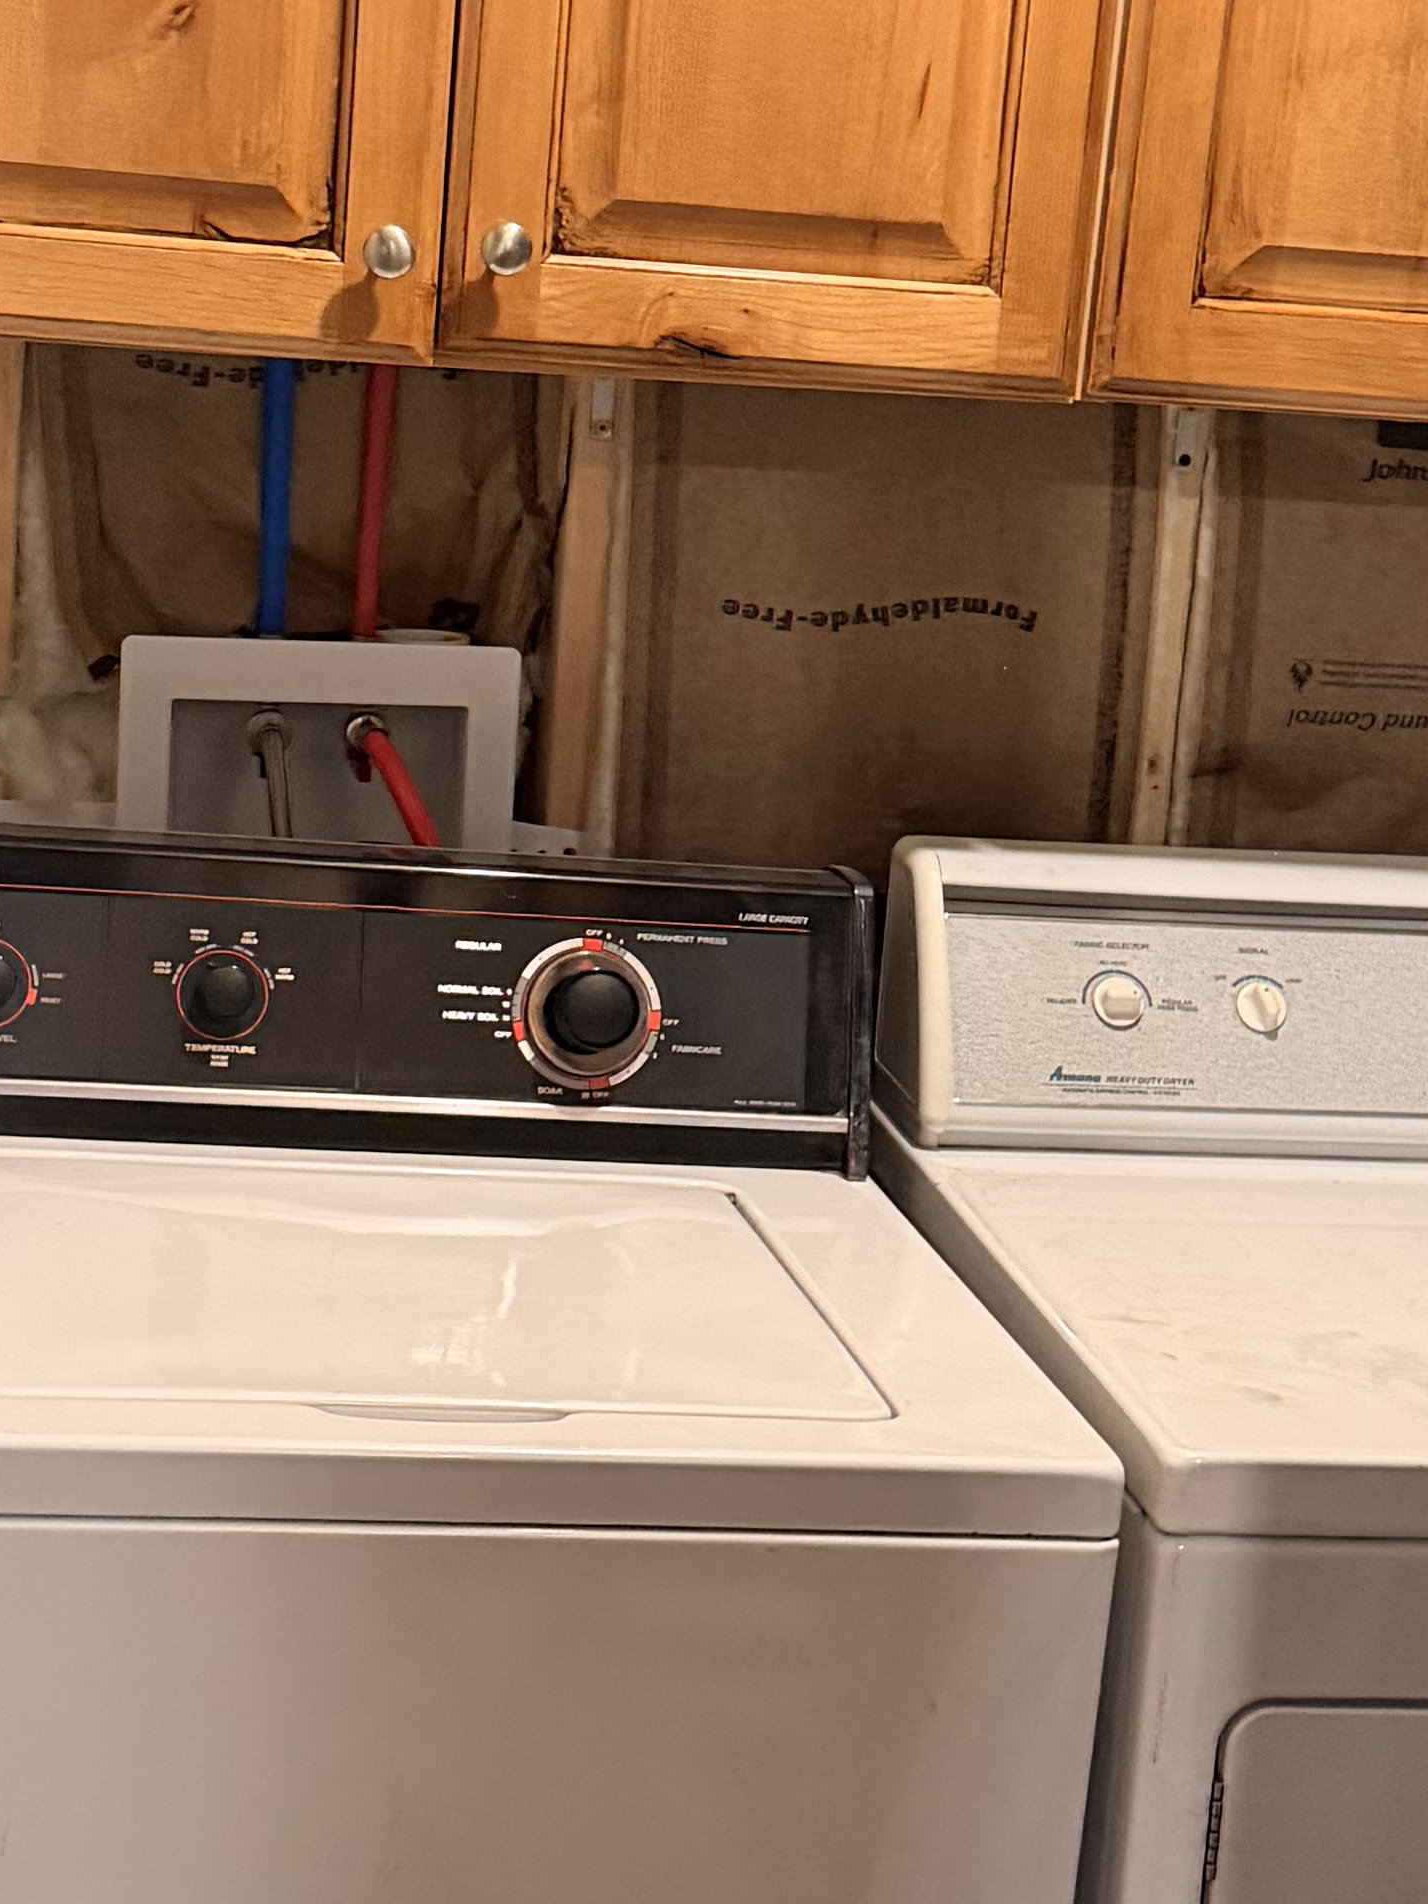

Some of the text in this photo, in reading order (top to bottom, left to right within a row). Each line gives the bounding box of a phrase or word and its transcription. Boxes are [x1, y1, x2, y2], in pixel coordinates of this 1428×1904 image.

[720, 596, 1039, 633] Formaldehyde-Free
[1286, 709, 1378, 732] Control
[585, 928, 604, 937] OFF
[637, 932, 728, 945] PERMANENT PRESS
[454, 939, 502, 951] REGULAR
[436, 984, 479, 995] NORMAL
[441, 1010, 475, 1021] HEAVY
[184, 1043, 257, 1055] TEMPERATURE
[1049, 1065, 1101, 1082] Amana
[1106, 1076, 1137, 1084] HEAVY
[1163, 1077, 1196, 1086] DRYER
